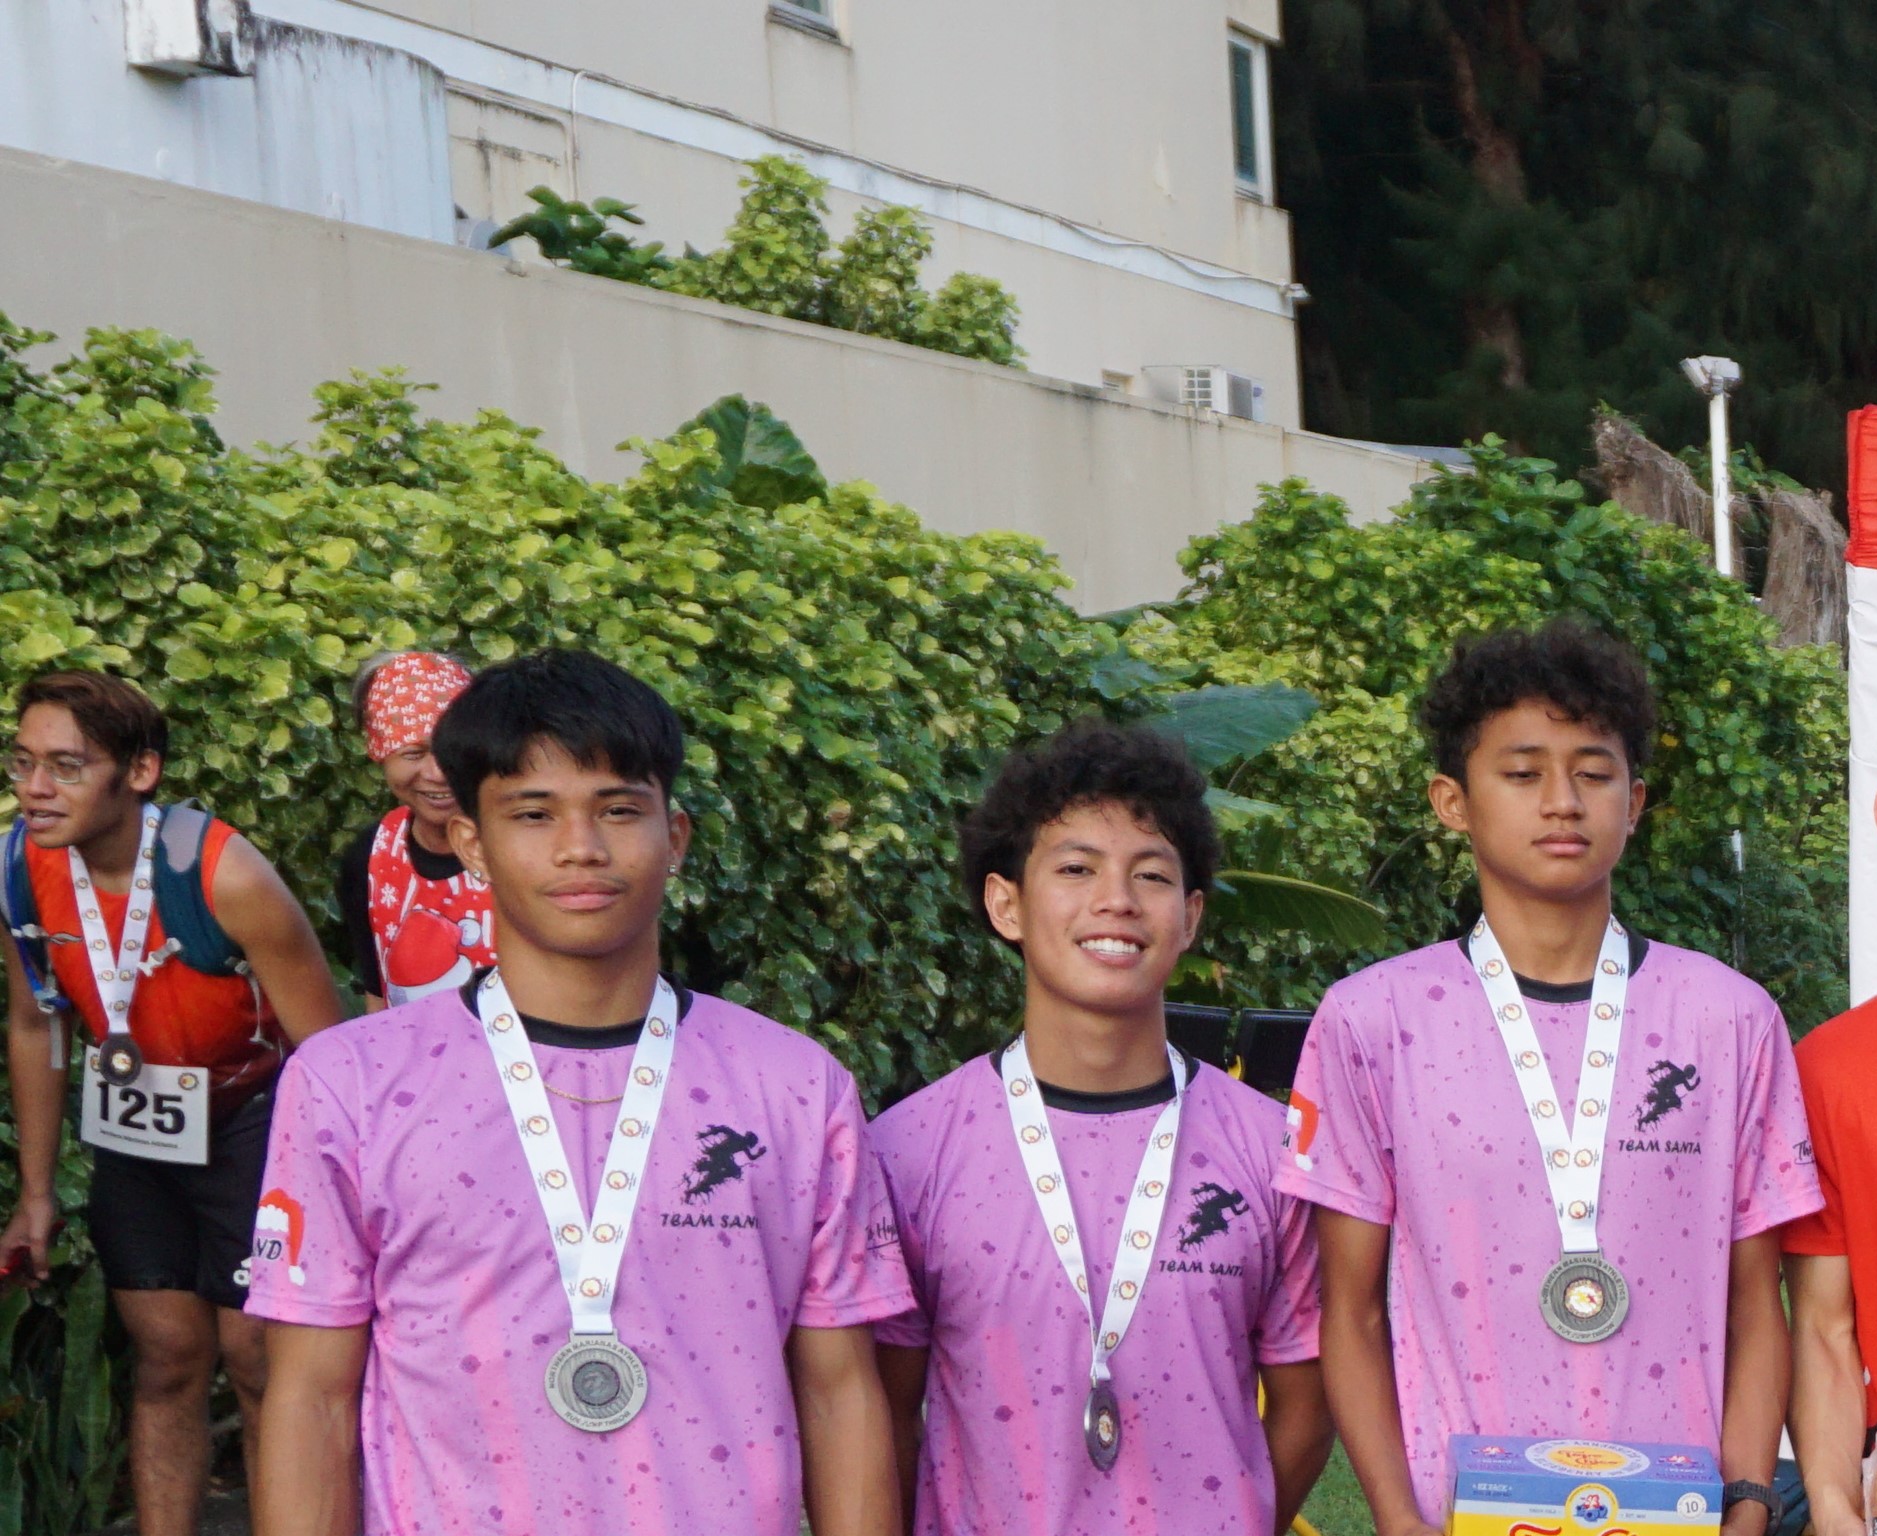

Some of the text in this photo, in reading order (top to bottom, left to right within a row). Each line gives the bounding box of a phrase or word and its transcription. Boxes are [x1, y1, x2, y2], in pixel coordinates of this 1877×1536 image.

[97, 1080, 186, 1134] 125
[1618, 1140, 1701, 1155] TEAM SANTA
[661, 1214, 758, 1229] TEAM SAN
[1159, 1260, 1243, 1276] TEAM SANT
[1685, 1501, 1699, 1514] 10
